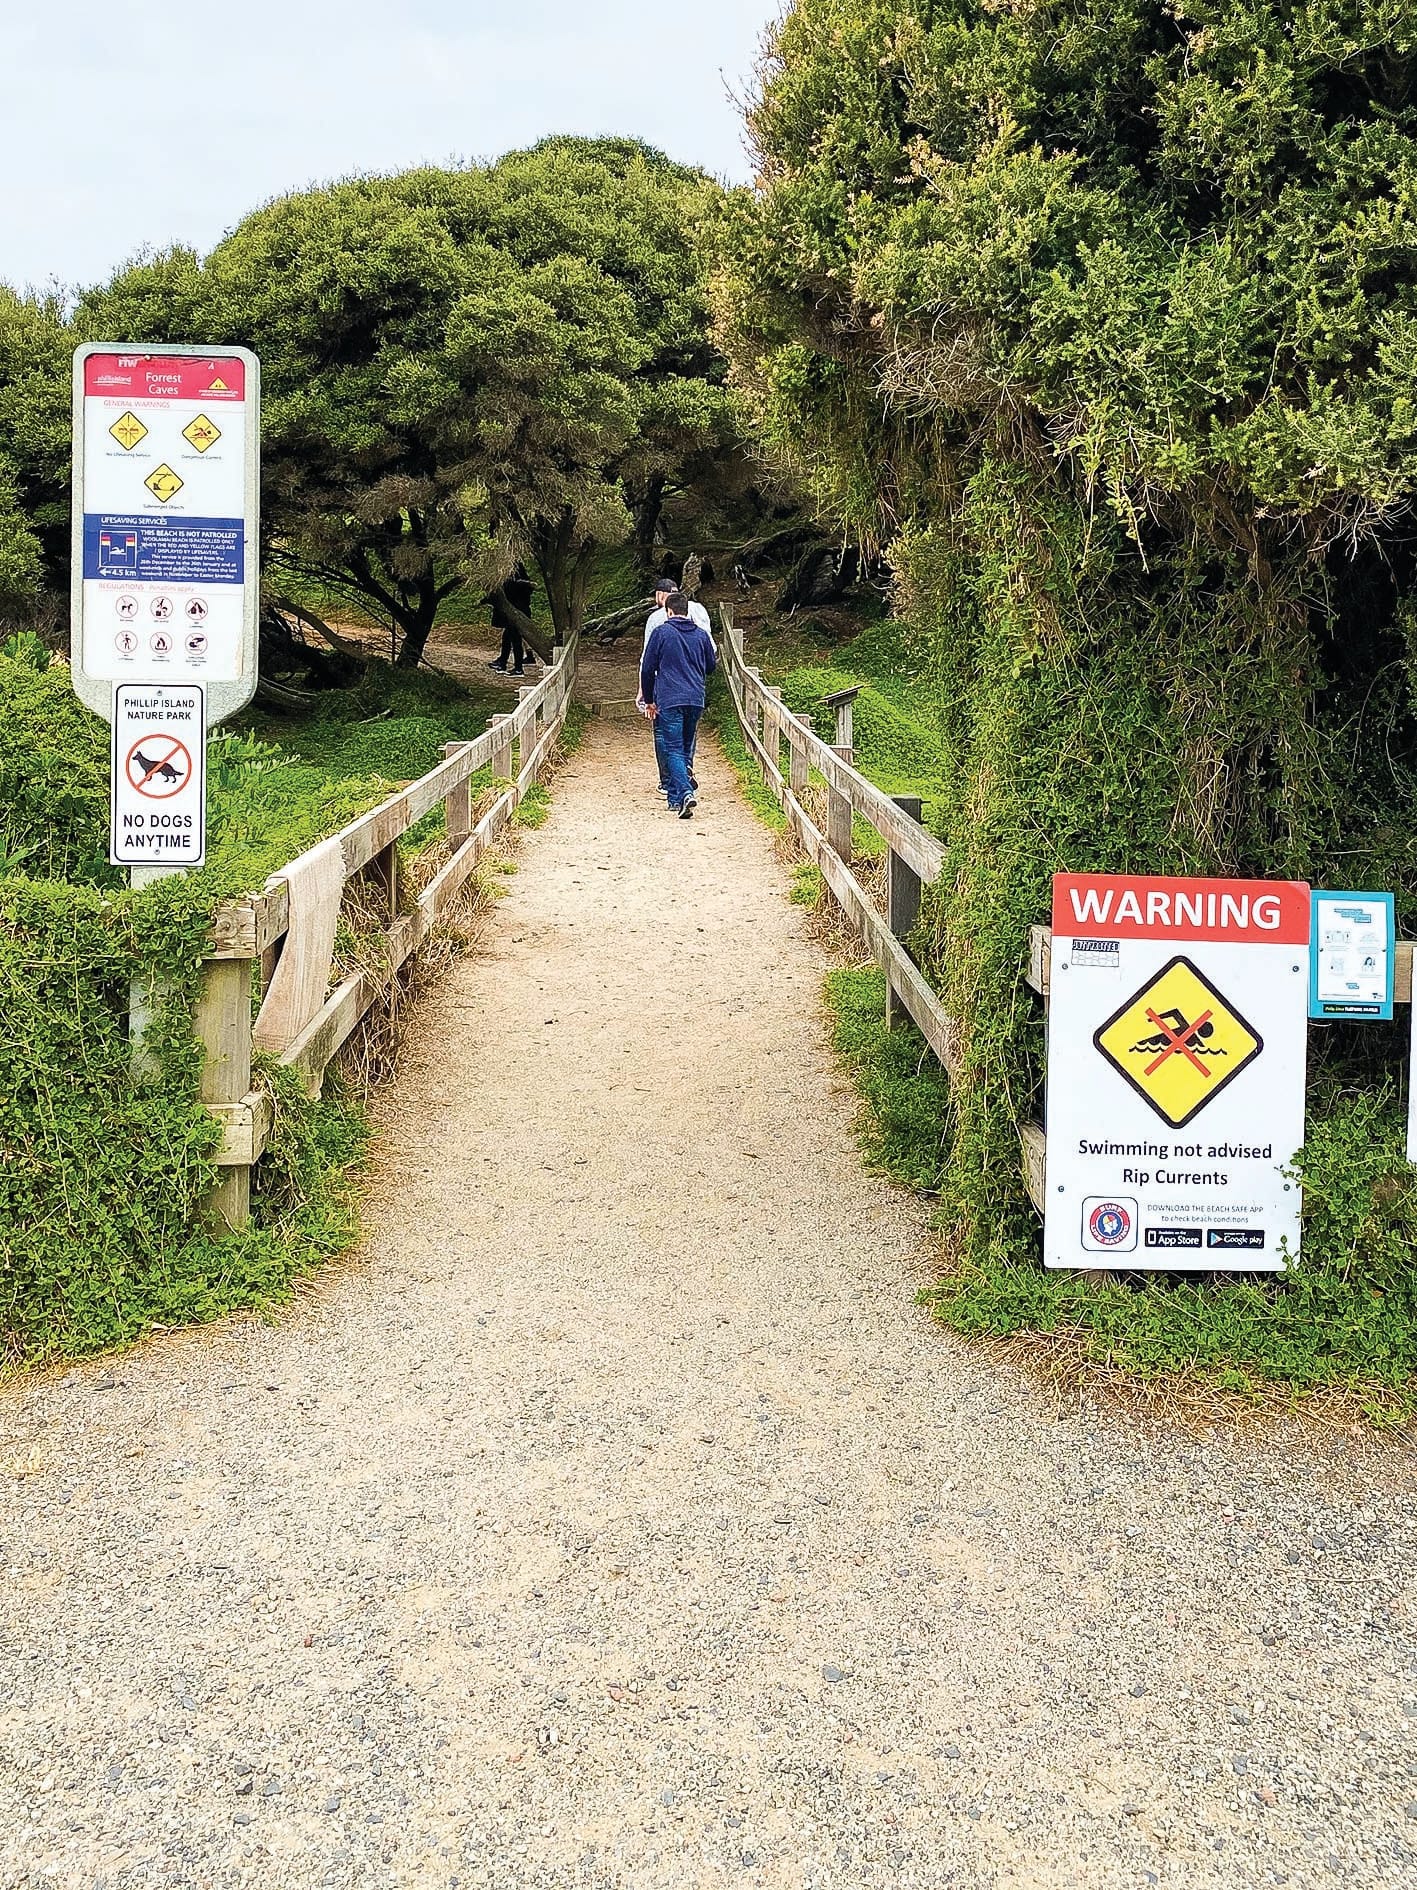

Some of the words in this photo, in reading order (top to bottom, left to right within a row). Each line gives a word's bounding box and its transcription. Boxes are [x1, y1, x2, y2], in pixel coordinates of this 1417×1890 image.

[146, 372, 182, 384] Forrest
[148, 384, 178, 395] Caves
[124, 699, 159, 708] PHILLIP
[161, 700, 194, 708] ISLAND
[128, 712, 164, 720] NATURE
[167, 712, 191, 720] PARK
[124, 815, 144, 828] NO
[150, 815, 192, 828] DOGS
[125, 835, 191, 847] ANYTIME
[1069, 888, 1281, 930] WARNING
[1078, 1140, 1168, 1159] Swimming
[1174, 1142, 1202, 1158] not
[1207, 1143, 1272, 1159] advised
[1123, 1168, 1150, 1186] Rip
[1155, 1170, 1228, 1185] Currents
[1158, 1235, 1172, 1246] App
[1174, 1235, 1199, 1245] Store
[1223, 1235, 1248, 1246] Google
[1250, 1236, 1263, 1246] play
